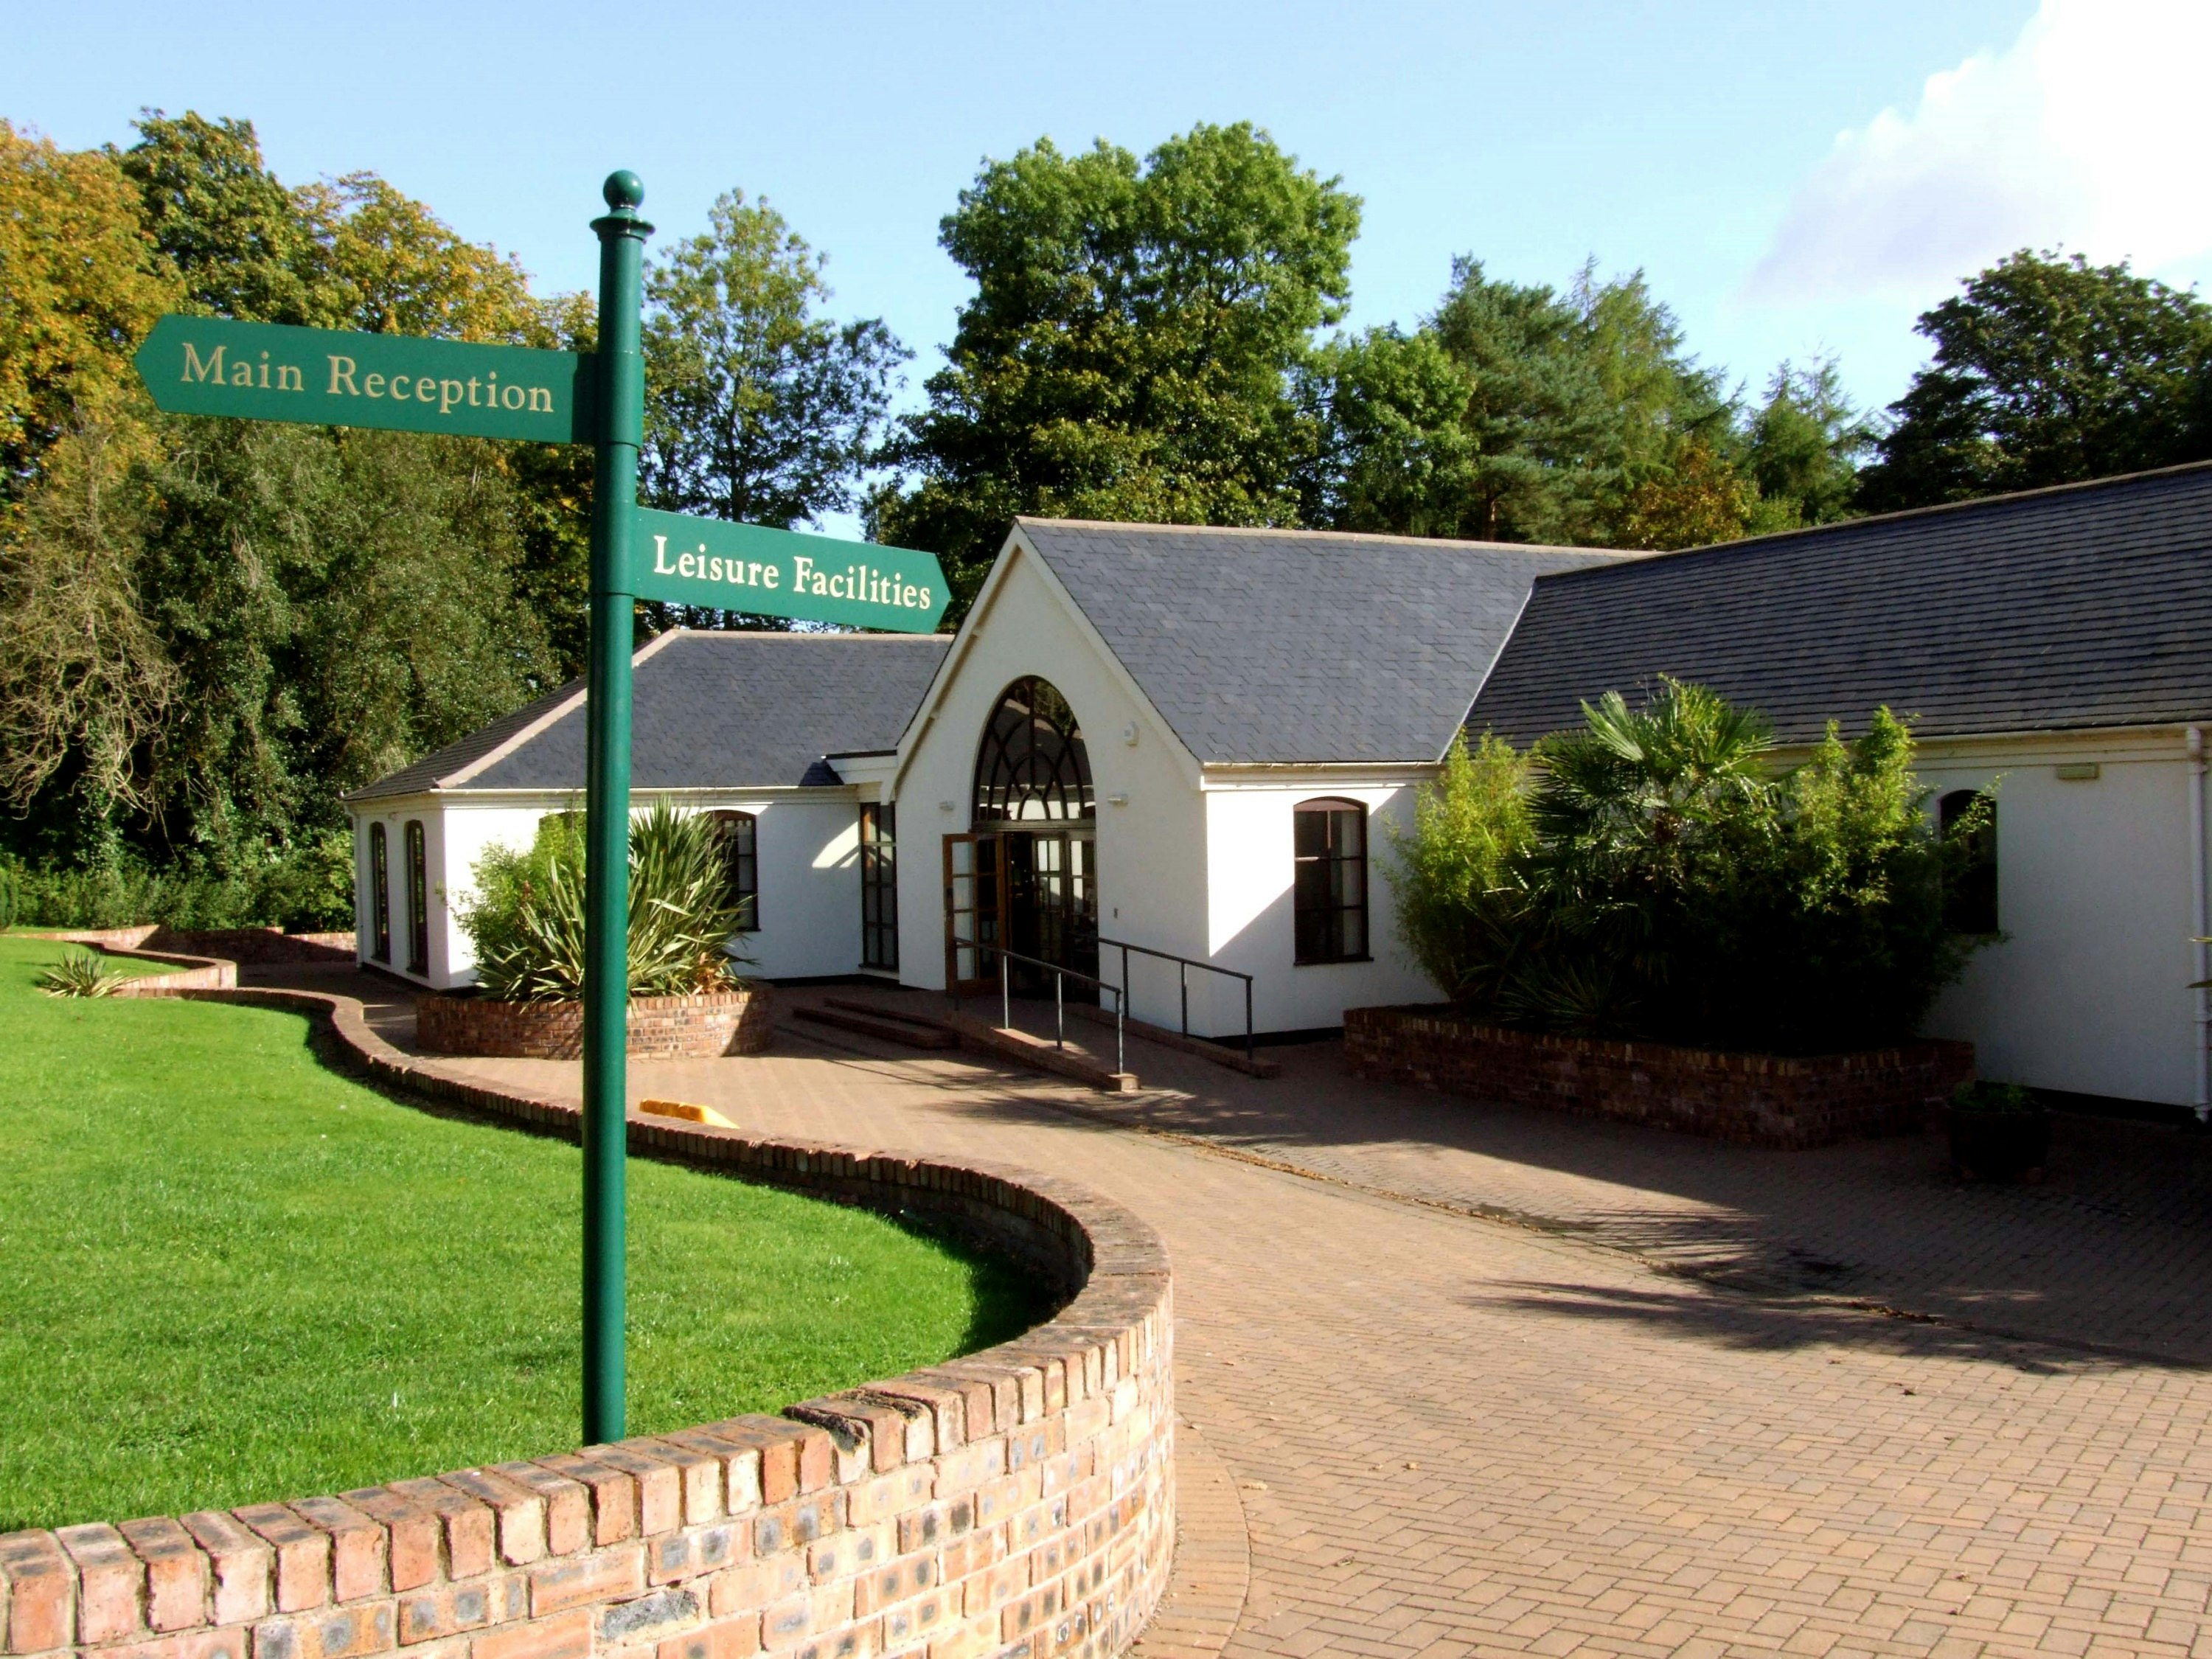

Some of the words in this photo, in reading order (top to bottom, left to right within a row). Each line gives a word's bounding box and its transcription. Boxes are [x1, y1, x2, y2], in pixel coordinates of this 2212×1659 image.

[181, 342, 304, 391] Main
[327, 355, 554, 414] Reception
[653, 535, 779, 588] Leisure
[793, 555, 931, 611] Facilities
